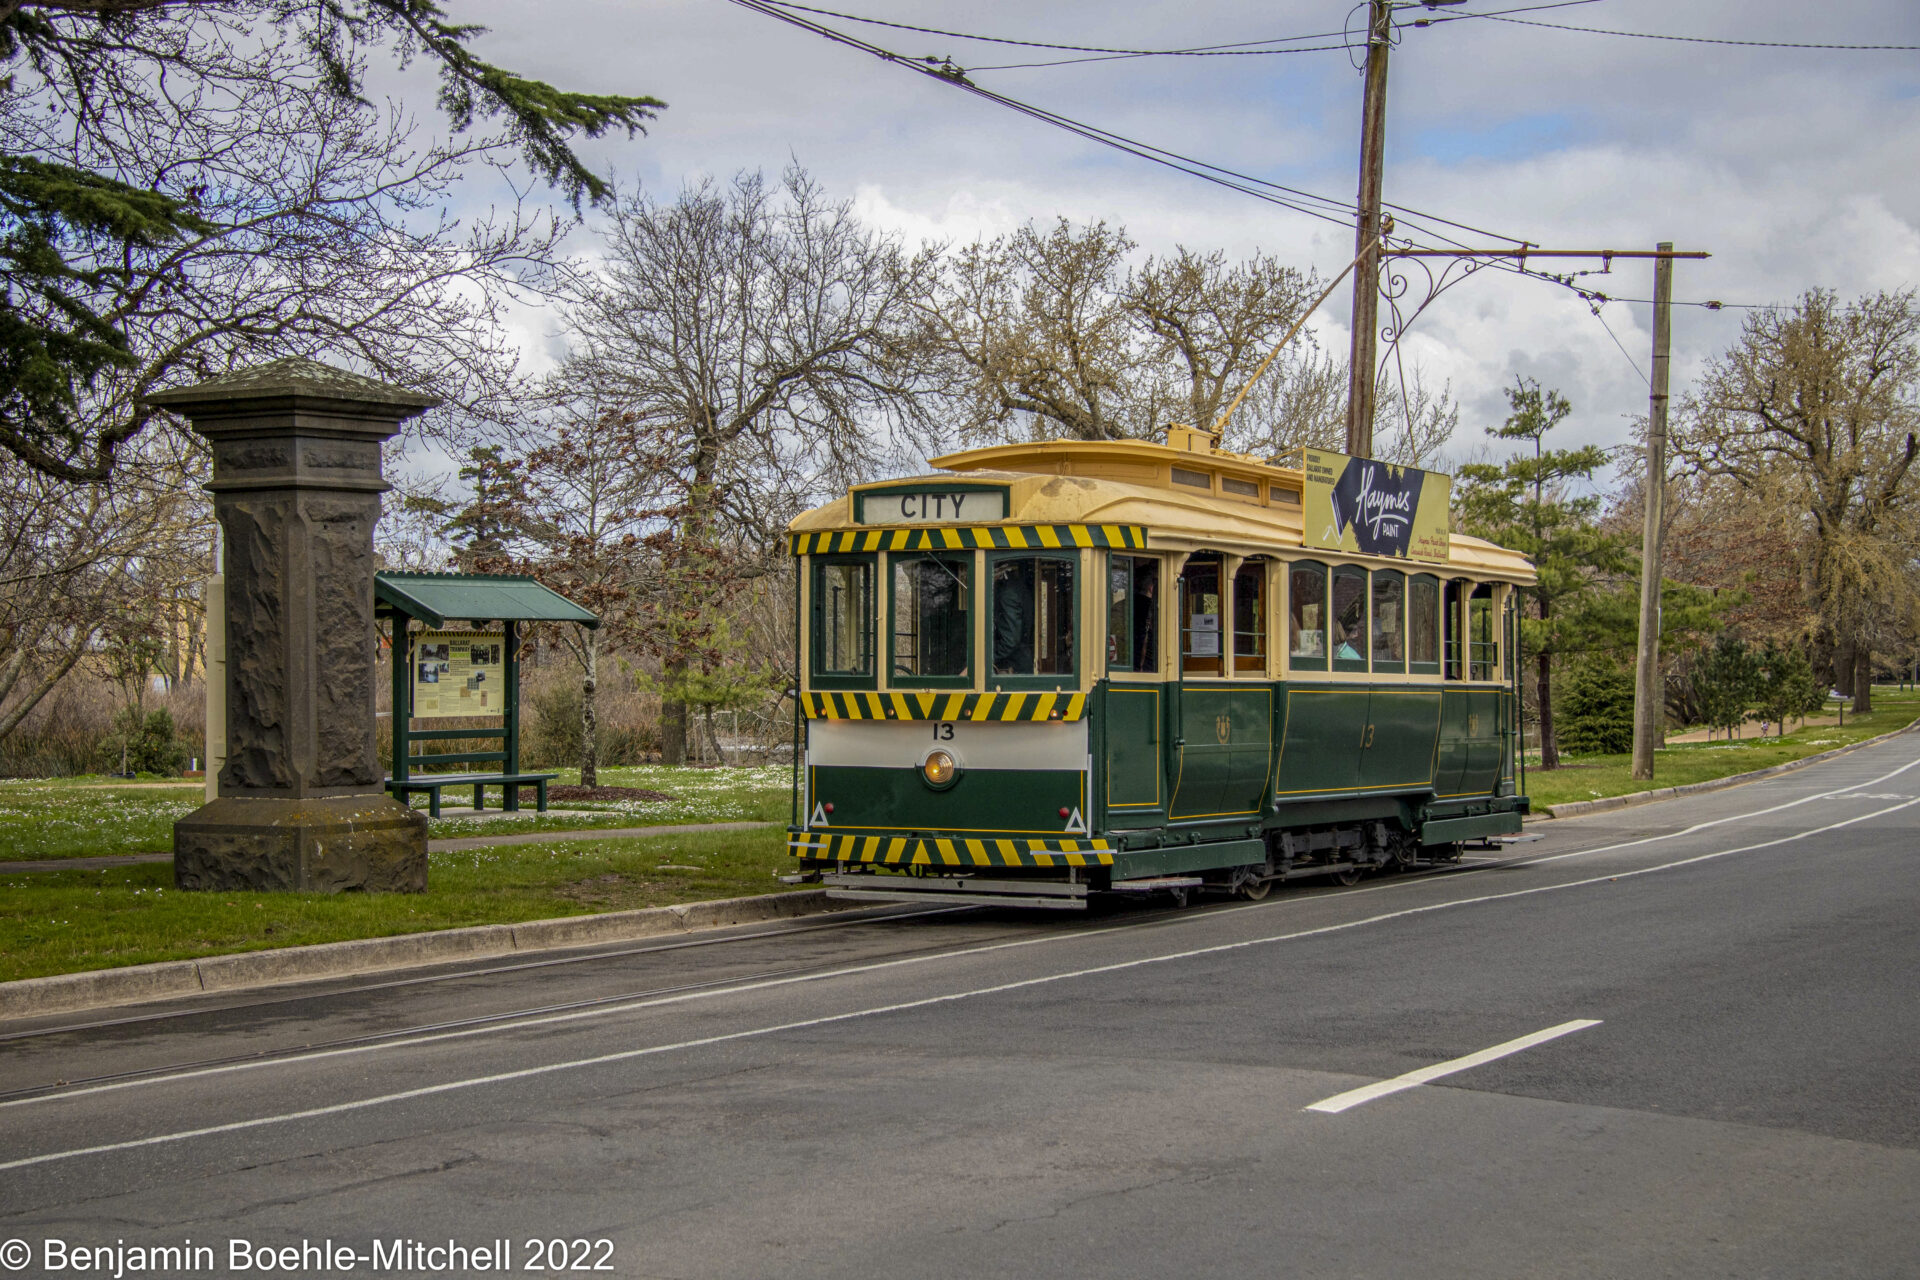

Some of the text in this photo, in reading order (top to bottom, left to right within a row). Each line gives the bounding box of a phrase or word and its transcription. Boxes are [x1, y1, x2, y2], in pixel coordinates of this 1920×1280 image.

[900, 494, 966, 519] CITY
[1355, 465, 1410, 541] Haymes
[1382, 522, 1400, 538] PAINT
[933, 723, 954, 740] 13
[1359, 720, 1375, 748] 13
